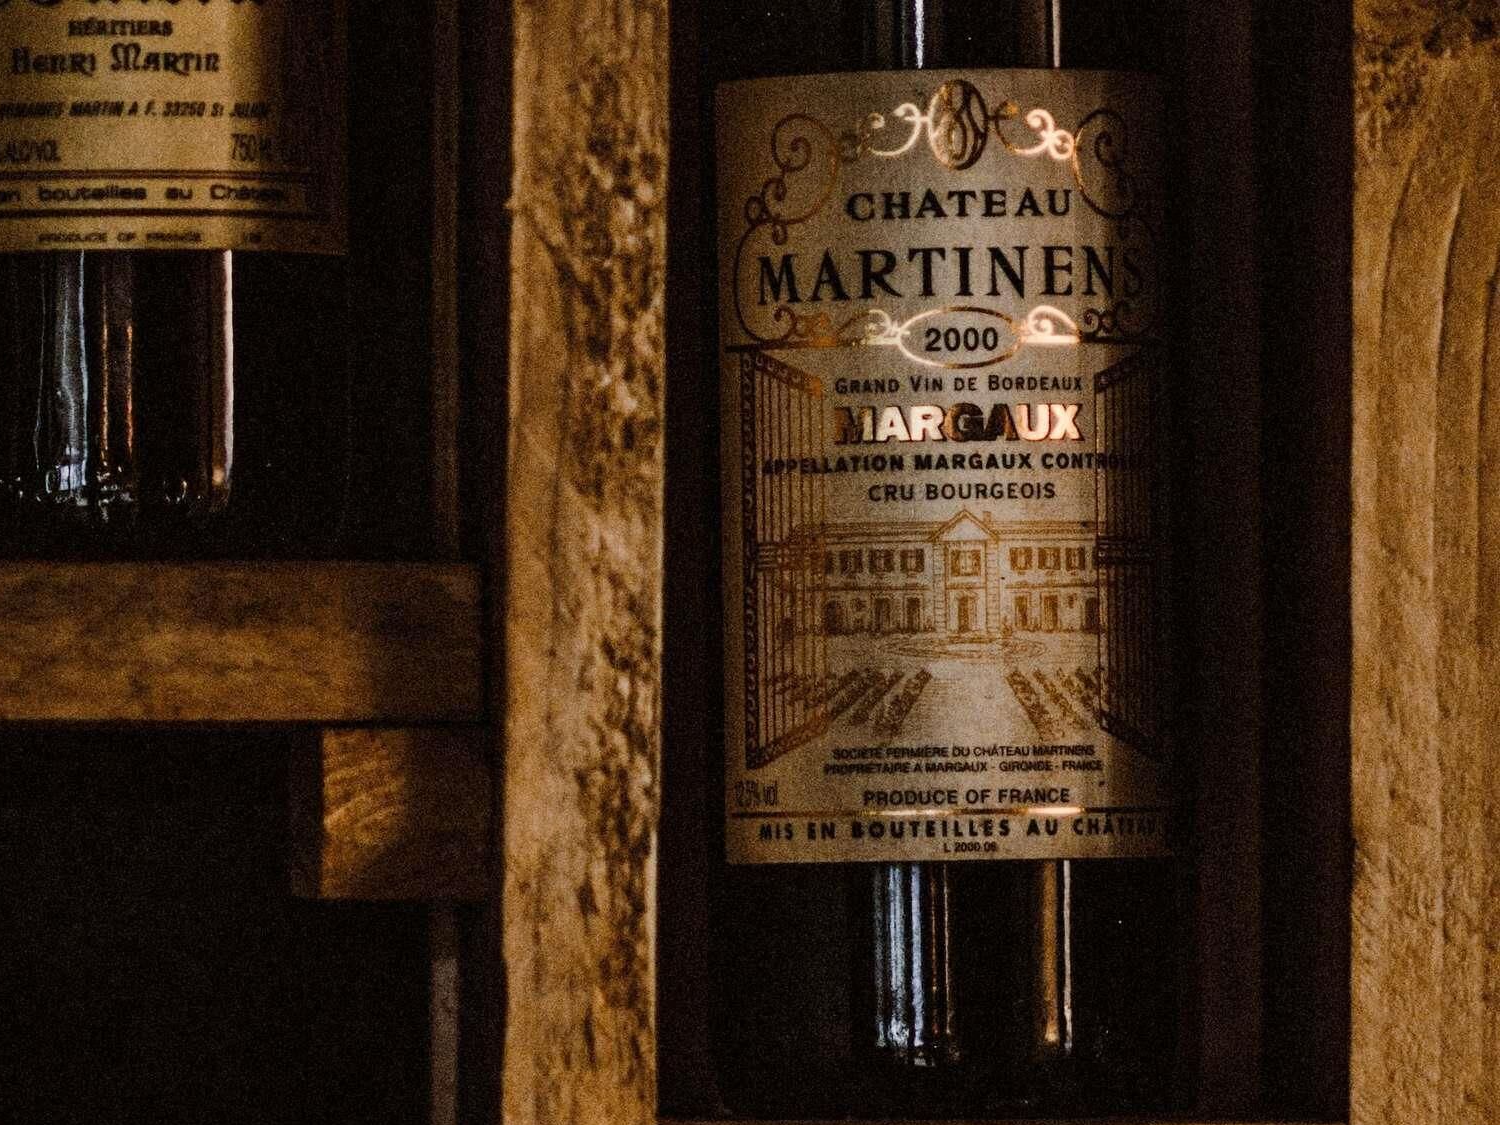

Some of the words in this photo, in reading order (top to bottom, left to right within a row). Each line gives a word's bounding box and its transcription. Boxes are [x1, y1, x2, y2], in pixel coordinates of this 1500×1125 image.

[67, 16, 174, 38] HÉRITIERS
[162, 100, 207, 118] 33250
[230, 132, 257, 163] 750
[37, 185, 147, 202] bouteilles
[164, 187, 194, 201] au
[843, 186, 1073, 222] CHATEAU
[756, 245, 1144, 306] MARTINENS
[924, 326, 1000, 352] 2000
[834, 376, 901, 395] GRAND
[953, 376, 979, 393] DE
[987, 374, 1084, 393] BORDEAUX
[834, 402, 1085, 445] MARGAUX
[762, 453, 904, 476] APPELLATION
[913, 452, 1033, 471] MARGAUX
[868, 483, 915, 502] CRU
[924, 482, 1057, 501] BOURGEOIS
[951, 746, 971, 758] DU
[973, 743, 1031, 758] CHÂTEAU
[1032, 744, 1096, 758] MARTINENS
[924, 760, 989, 774] MARGAUX
[1061, 758, 1104, 773] FRANCE
[863, 790, 960, 807] PRODUCE
[965, 788, 992, 805] OF
[998, 788, 1072, 804] FRANCE
[759, 822, 794, 841] MIS
[807, 821, 837, 841] EN
[850, 818, 1011, 840] BOUTEILLES
[1026, 818, 1060, 837] AU
